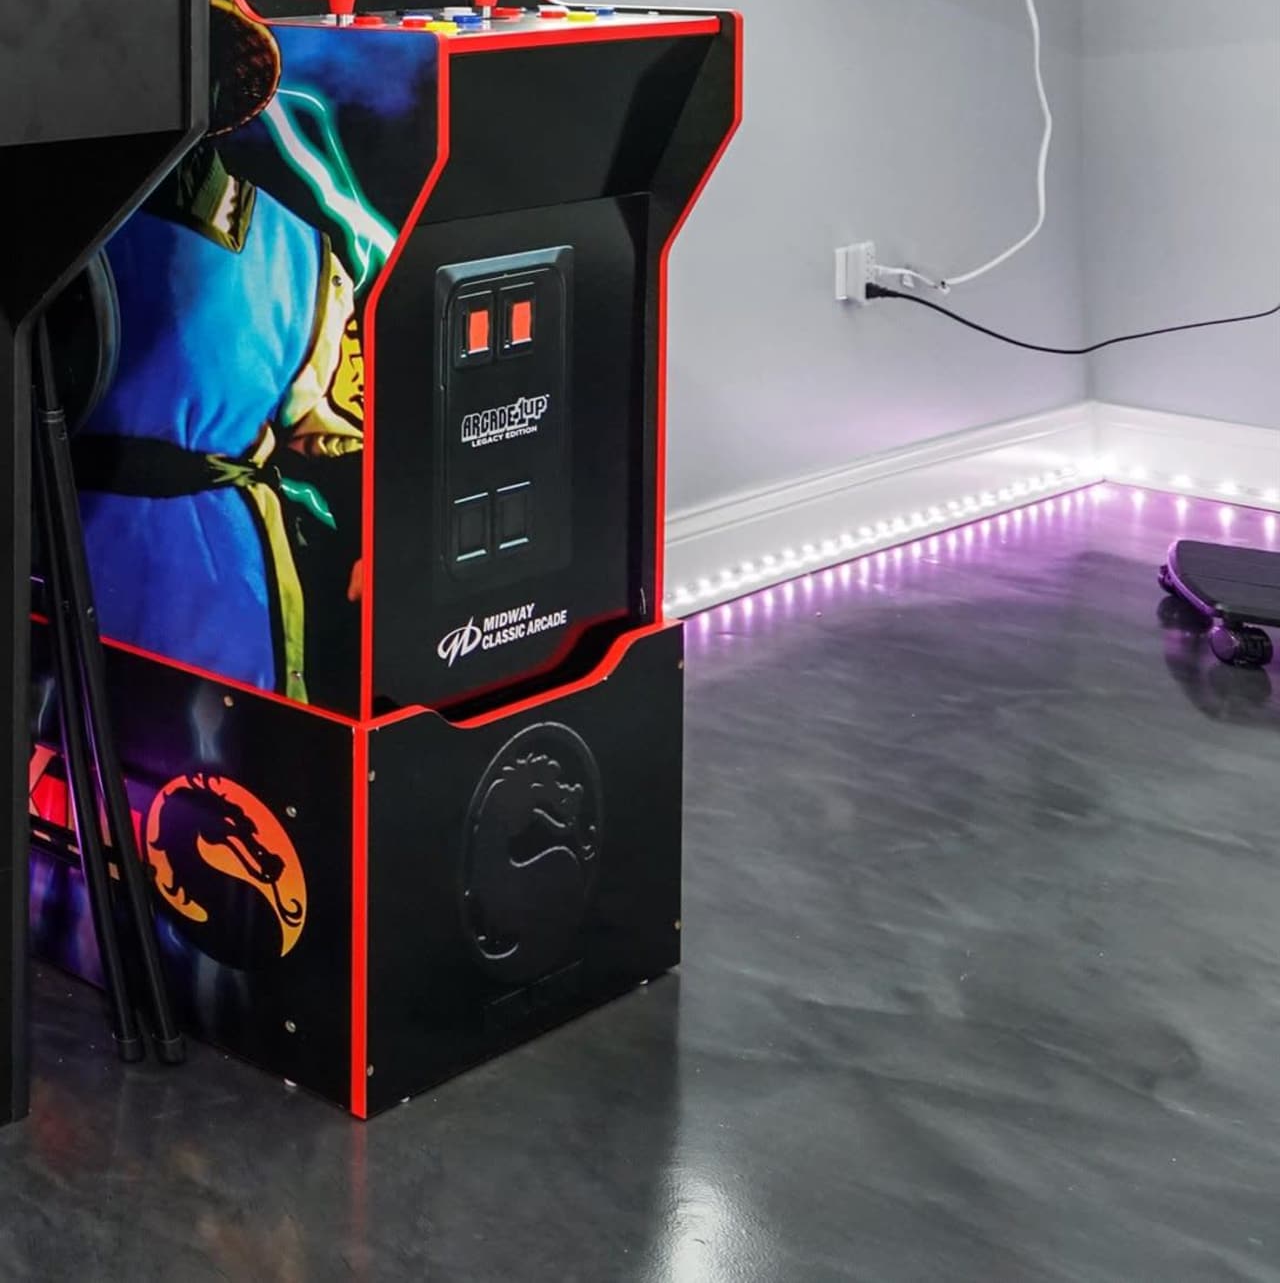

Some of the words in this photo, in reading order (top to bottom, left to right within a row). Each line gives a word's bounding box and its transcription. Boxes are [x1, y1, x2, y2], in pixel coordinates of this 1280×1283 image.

[472, 433, 503, 448] LEGACY
[505, 425, 538, 440] EDITION
[482, 625, 526, 650] CLASSIC
[526, 610, 568, 636] ARCADE
[483, 602, 535, 633] MIDWAY
